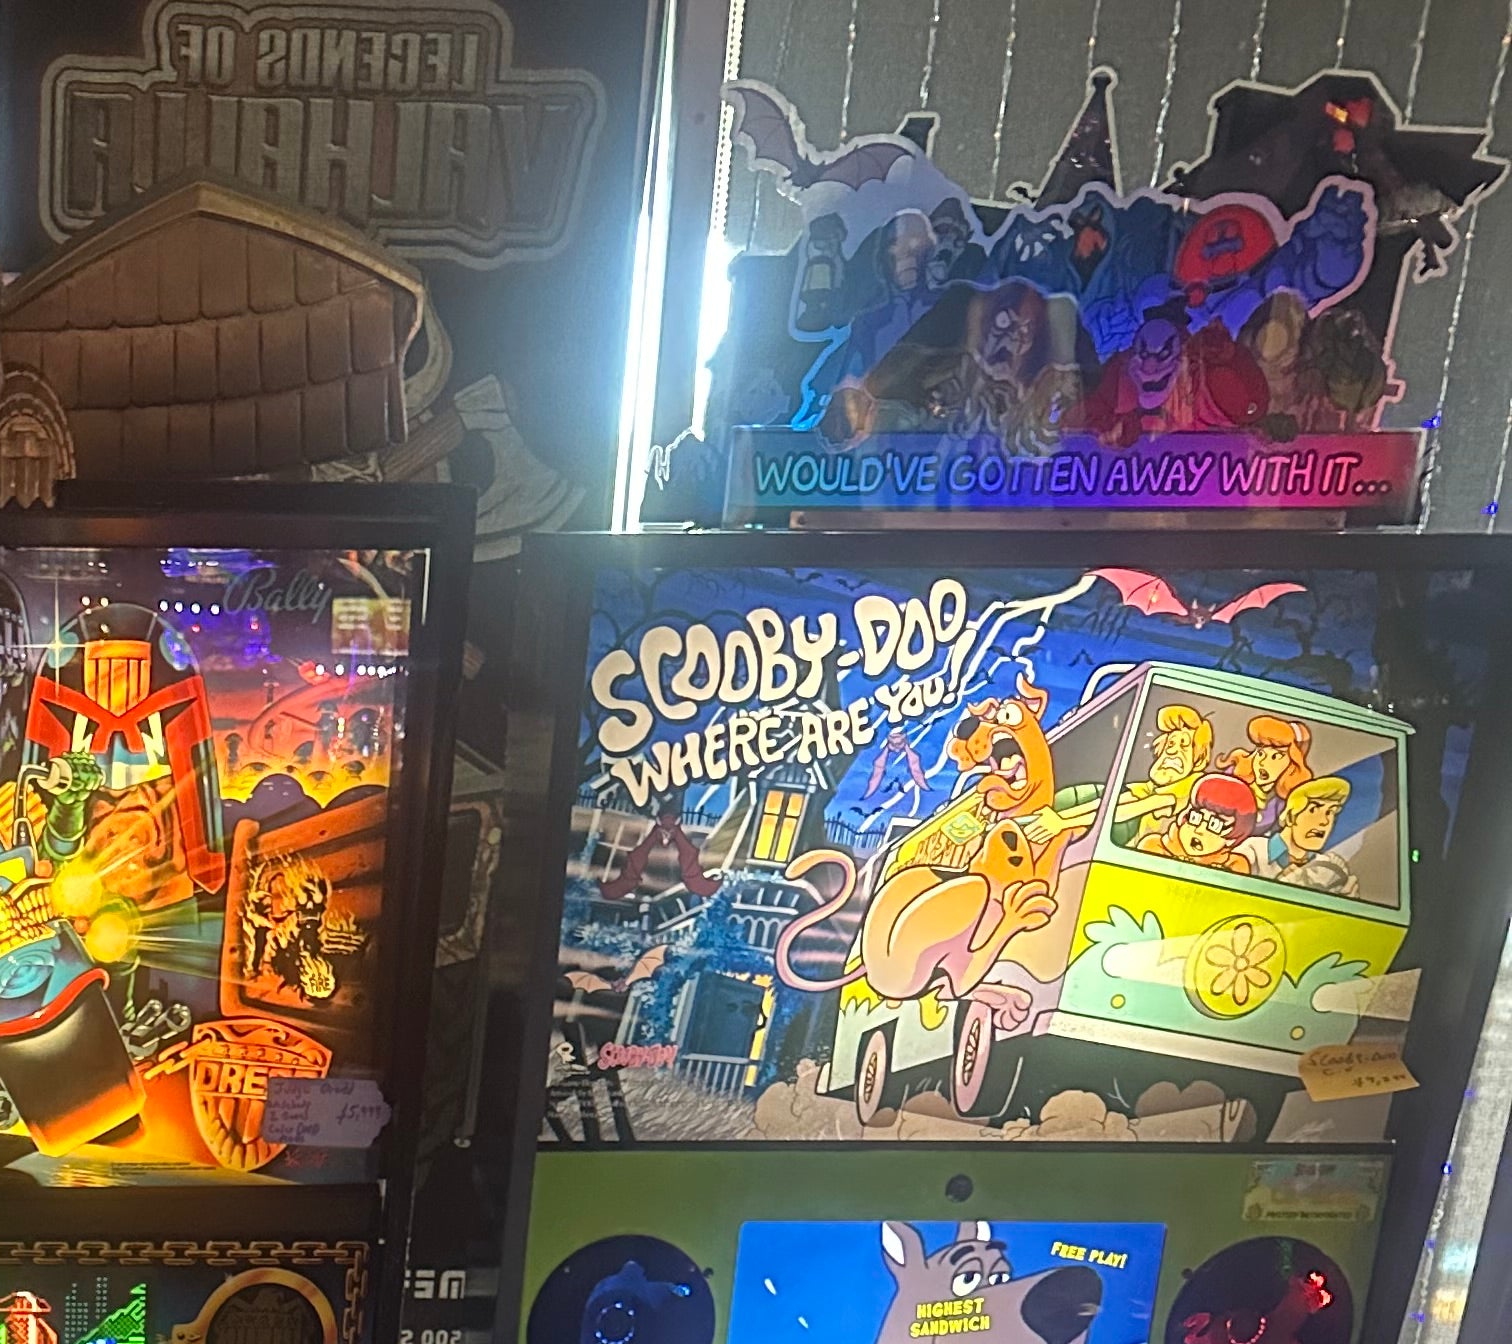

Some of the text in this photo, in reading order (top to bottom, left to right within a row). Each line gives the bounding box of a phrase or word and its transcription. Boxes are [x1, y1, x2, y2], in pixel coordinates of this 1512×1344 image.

[756, 450, 937, 497] WOULD'VE
[948, 452, 1097, 497] GOTTEN
[1108, 452, 1214, 496] AWAY
[1221, 453, 1311, 496] WITH
[223, 568, 332, 624] Bally
[610, 715, 785, 808] WHERE
[796, 697, 875, 765] ARE
[1050, 1241, 1128, 1269] FREE PLAY!
[909, 1314, 991, 1339] SANDWICH
[916, 1297, 985, 1320] HIGHEST
